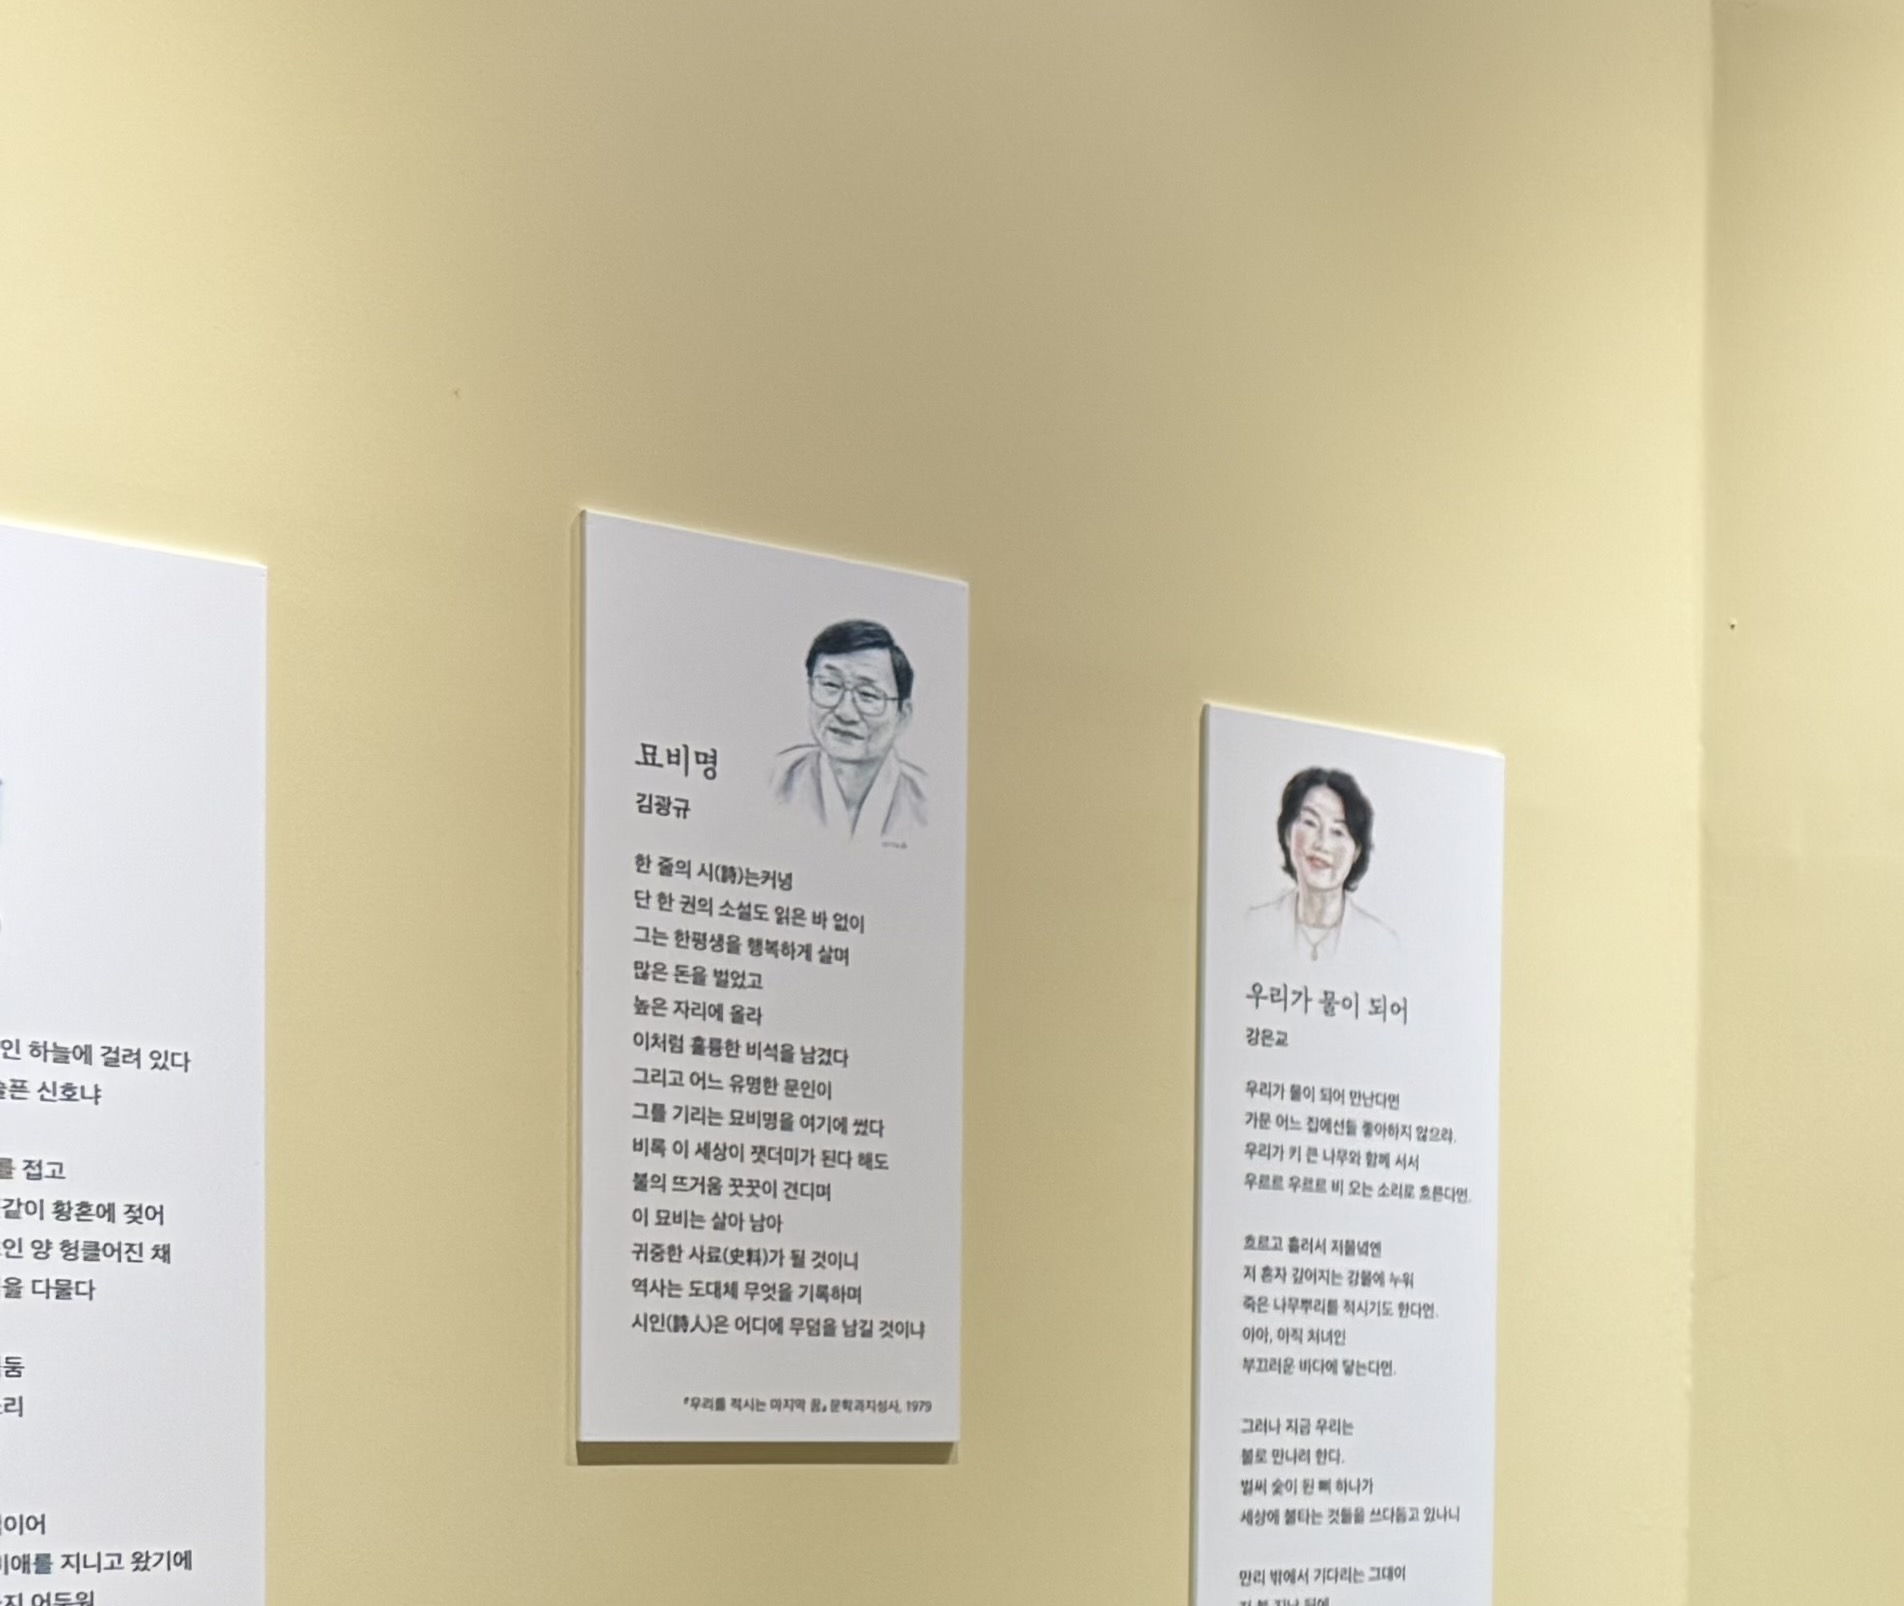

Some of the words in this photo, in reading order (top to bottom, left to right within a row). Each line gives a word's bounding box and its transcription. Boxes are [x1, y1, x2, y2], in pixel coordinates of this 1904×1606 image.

[634, 741, 718, 780] 묘비명
[635, 792, 691, 820] 김광규
[634, 853, 652, 874] 한
[656, 856, 691, 880] 줄의
[633, 889, 652, 910] 단
[655, 891, 675, 912] 한
[678, 894, 713, 917] 권의
[717, 900, 769, 922] 소설도
[773, 906, 807, 928] 읽은
[811, 910, 828, 930] 바
[831, 912, 864, 934] 없이
[632, 926, 669, 947] 그는
[673, 929, 742, 955] 한평생을
[746, 937, 812, 962] 행복하게
[817, 945, 849, 967] 살며
[633, 960, 668, 982] 많은
[672, 964, 707, 987] 돈을
[712, 968, 763, 990] 벌었고
[632, 995, 668, 1017] 높은
[672, 1000, 724, 1023] 자리에
[728, 1004, 763, 1027] 올라
[1245, 982, 1313, 1015] 우리가
[1317, 990, 1359, 1020] 물이
[1367, 994, 1407, 1025] 되어
[632, 1031, 684, 1054] 이처럼
[745, 1041, 795, 1064] 비석을
[799, 1045, 849, 1068] 남겼다
[1245, 1027, 1288, 1048] 강은교
[27, 1041, 92, 1066] 하늘에
[99, 1046, 141, 1069] 걸려
[148, 1049, 191, 1073] 있다
[36, 1081, 102, 1106] 신호냐
[631, 1067, 685, 1088] 그리고
[688, 1071, 724, 1091] 어느
[728, 1074, 779, 1096] 유명한
[783, 1078, 831, 1101] 문인이
[631, 1103, 667, 1123] 그를
[672, 1105, 724, 1127] 기리는
[727, 1109, 794, 1132] 묘비명을
[798, 1114, 848, 1135] 여기에
[632, 1137, 667, 1158] 비록
[671, 1139, 689, 1160] 이
[694, 1141, 744, 1163] 세상이
[750, 1145, 816, 1168] 잿더미가
[819, 1149, 853, 1170] 된다
[856, 1152, 888, 1170] 해도
[21, 1159, 66, 1181] 접고
[782, 1181, 831, 1202] 견디며
[51, 1200, 116, 1224] 황혼에
[122, 1203, 164, 1226] 젖어
[631, 1207, 648, 1227] 이
[653, 1209, 706, 1230] 묘비는
[710, 1211, 745, 1232] 살아
[748, 1213, 783, 1234] 남아
[29, 1239, 53, 1260] 양
[58, 1239, 144, 1263] 헝클어진
[150, 1243, 171, 1264] 채
[630, 1242, 683, 1264] 귀중한
[810, 1250, 858, 1271] 것이니
[30, 1278, 96, 1301] 다물다
[631, 1277, 683, 1298] 역사는
[687, 1280, 738, 1300] 도대체
[743, 1282, 793, 1302] 무엇을
[797, 1284, 861, 1305] 기록하며
[733, 1316, 784, 1336] 어디에
[788, 1317, 837, 1337] 무덤을
[841, 1319, 873, 1338] 남길
[878, 1320, 925, 1339] 것이냐
[905, 1401, 932, 1412] 1979
[59, 1551, 125, 1574] 지니고
[129, 1550, 192, 1572] 왔기에
